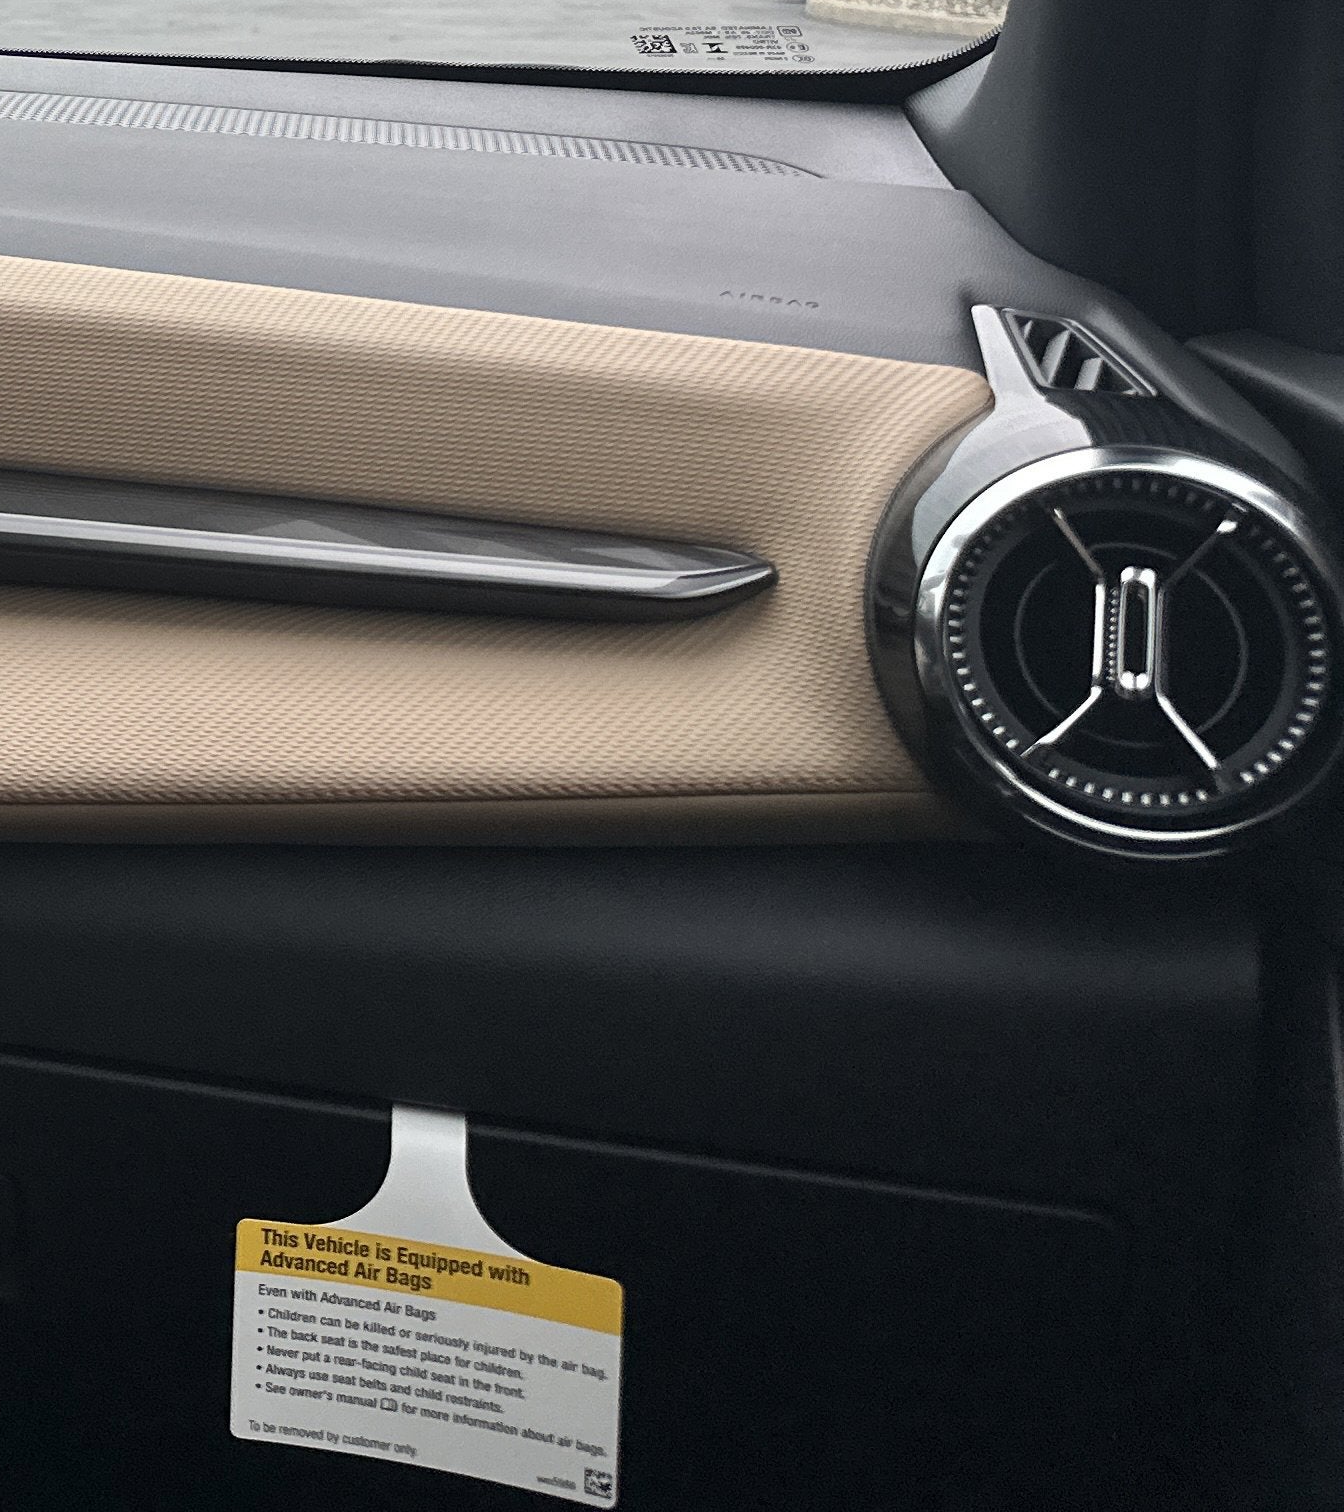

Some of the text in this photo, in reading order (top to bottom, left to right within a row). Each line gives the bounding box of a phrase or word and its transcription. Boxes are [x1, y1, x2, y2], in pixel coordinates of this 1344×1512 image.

[260, 1250, 432, 1292] Advanced Air Bags
[261, 1228, 530, 1285] This Vehicle is Equipped with
[258, 1283, 437, 1322] Even with Advanced Air Bags
[267, 1325, 523, 1380] The back seat is the safest place for children.
[268, 1307, 316, 1324] Children
[319, 1316, 341, 1327] can
[344, 1318, 360, 1331] be
[363, 1321, 395, 1337] killed
[398, 1326, 412, 1338] or
[415, 1330, 469, 1351] seriously
[473, 1341, 517, 1358] injured
[519, 1349, 534, 1365] by
[538, 1353, 557, 1368] the
[561, 1360, 578, 1372] air
[265, 1363, 504, 1414] Always use seat belts and child restraints.
[266, 1344, 299, 1359] Never
[302, 1350, 320, 1363] put
[323, 1353, 331, 1363] a
[333, 1355, 397, 1376] rear-facing
[399, 1365, 428, 1380] child
[431, 1371, 456, 1384] seat
[459, 1376, 469, 1388] in
[473, 1378, 491, 1392] the
[248, 1419, 391, 1451] To be removed by customer
[265, 1381, 286, 1395] See
[289, 1386, 333, 1401] owner's
[336, 1392, 377, 1408] manual
[401, 1402, 418, 1415] for
[420, 1407, 449, 1421] more
[453, 1414, 518, 1436] information
[520, 1428, 555, 1444] about
[557, 1436, 573, 1447] air
